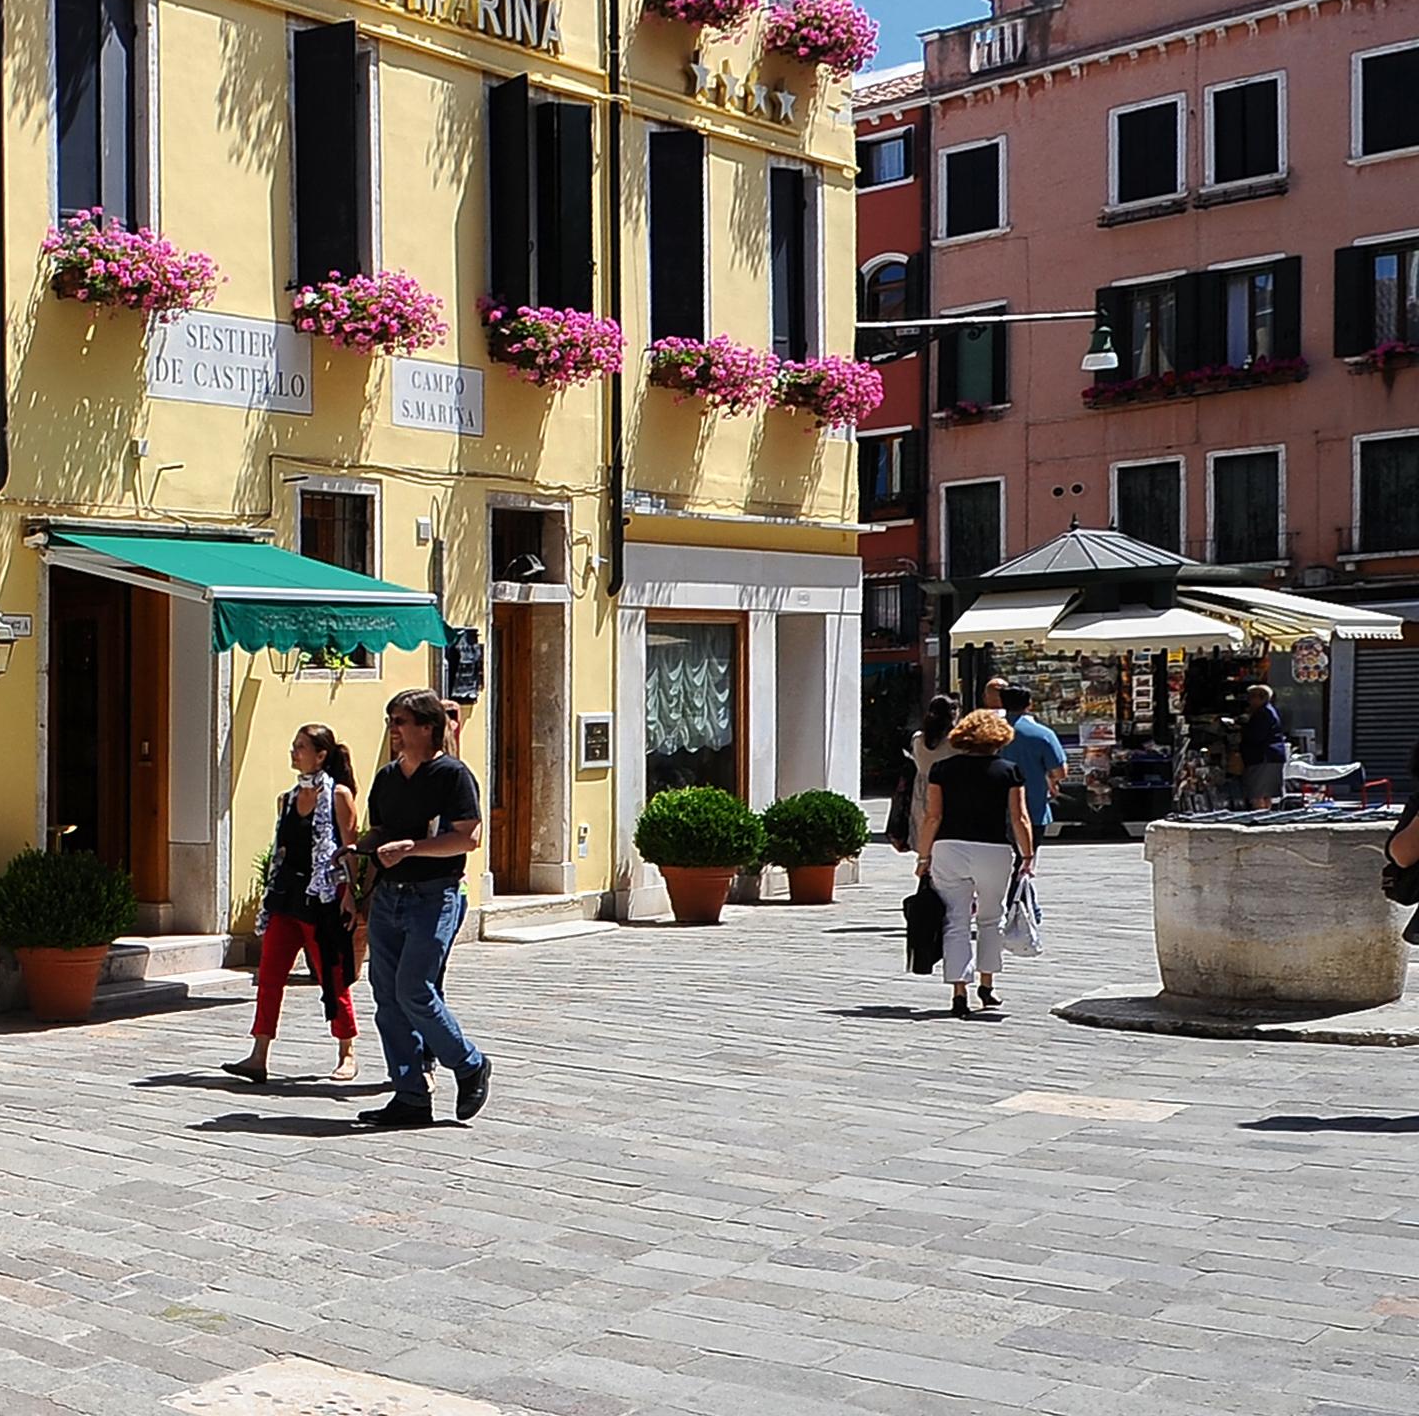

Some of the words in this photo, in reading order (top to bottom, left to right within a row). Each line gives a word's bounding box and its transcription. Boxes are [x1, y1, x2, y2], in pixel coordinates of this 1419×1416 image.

[186, 324, 276, 359] SESTIER
[155, 357, 184, 385] DE
[193, 362, 305, 398] CASTELLO
[411, 370, 464, 395] CAMPO
